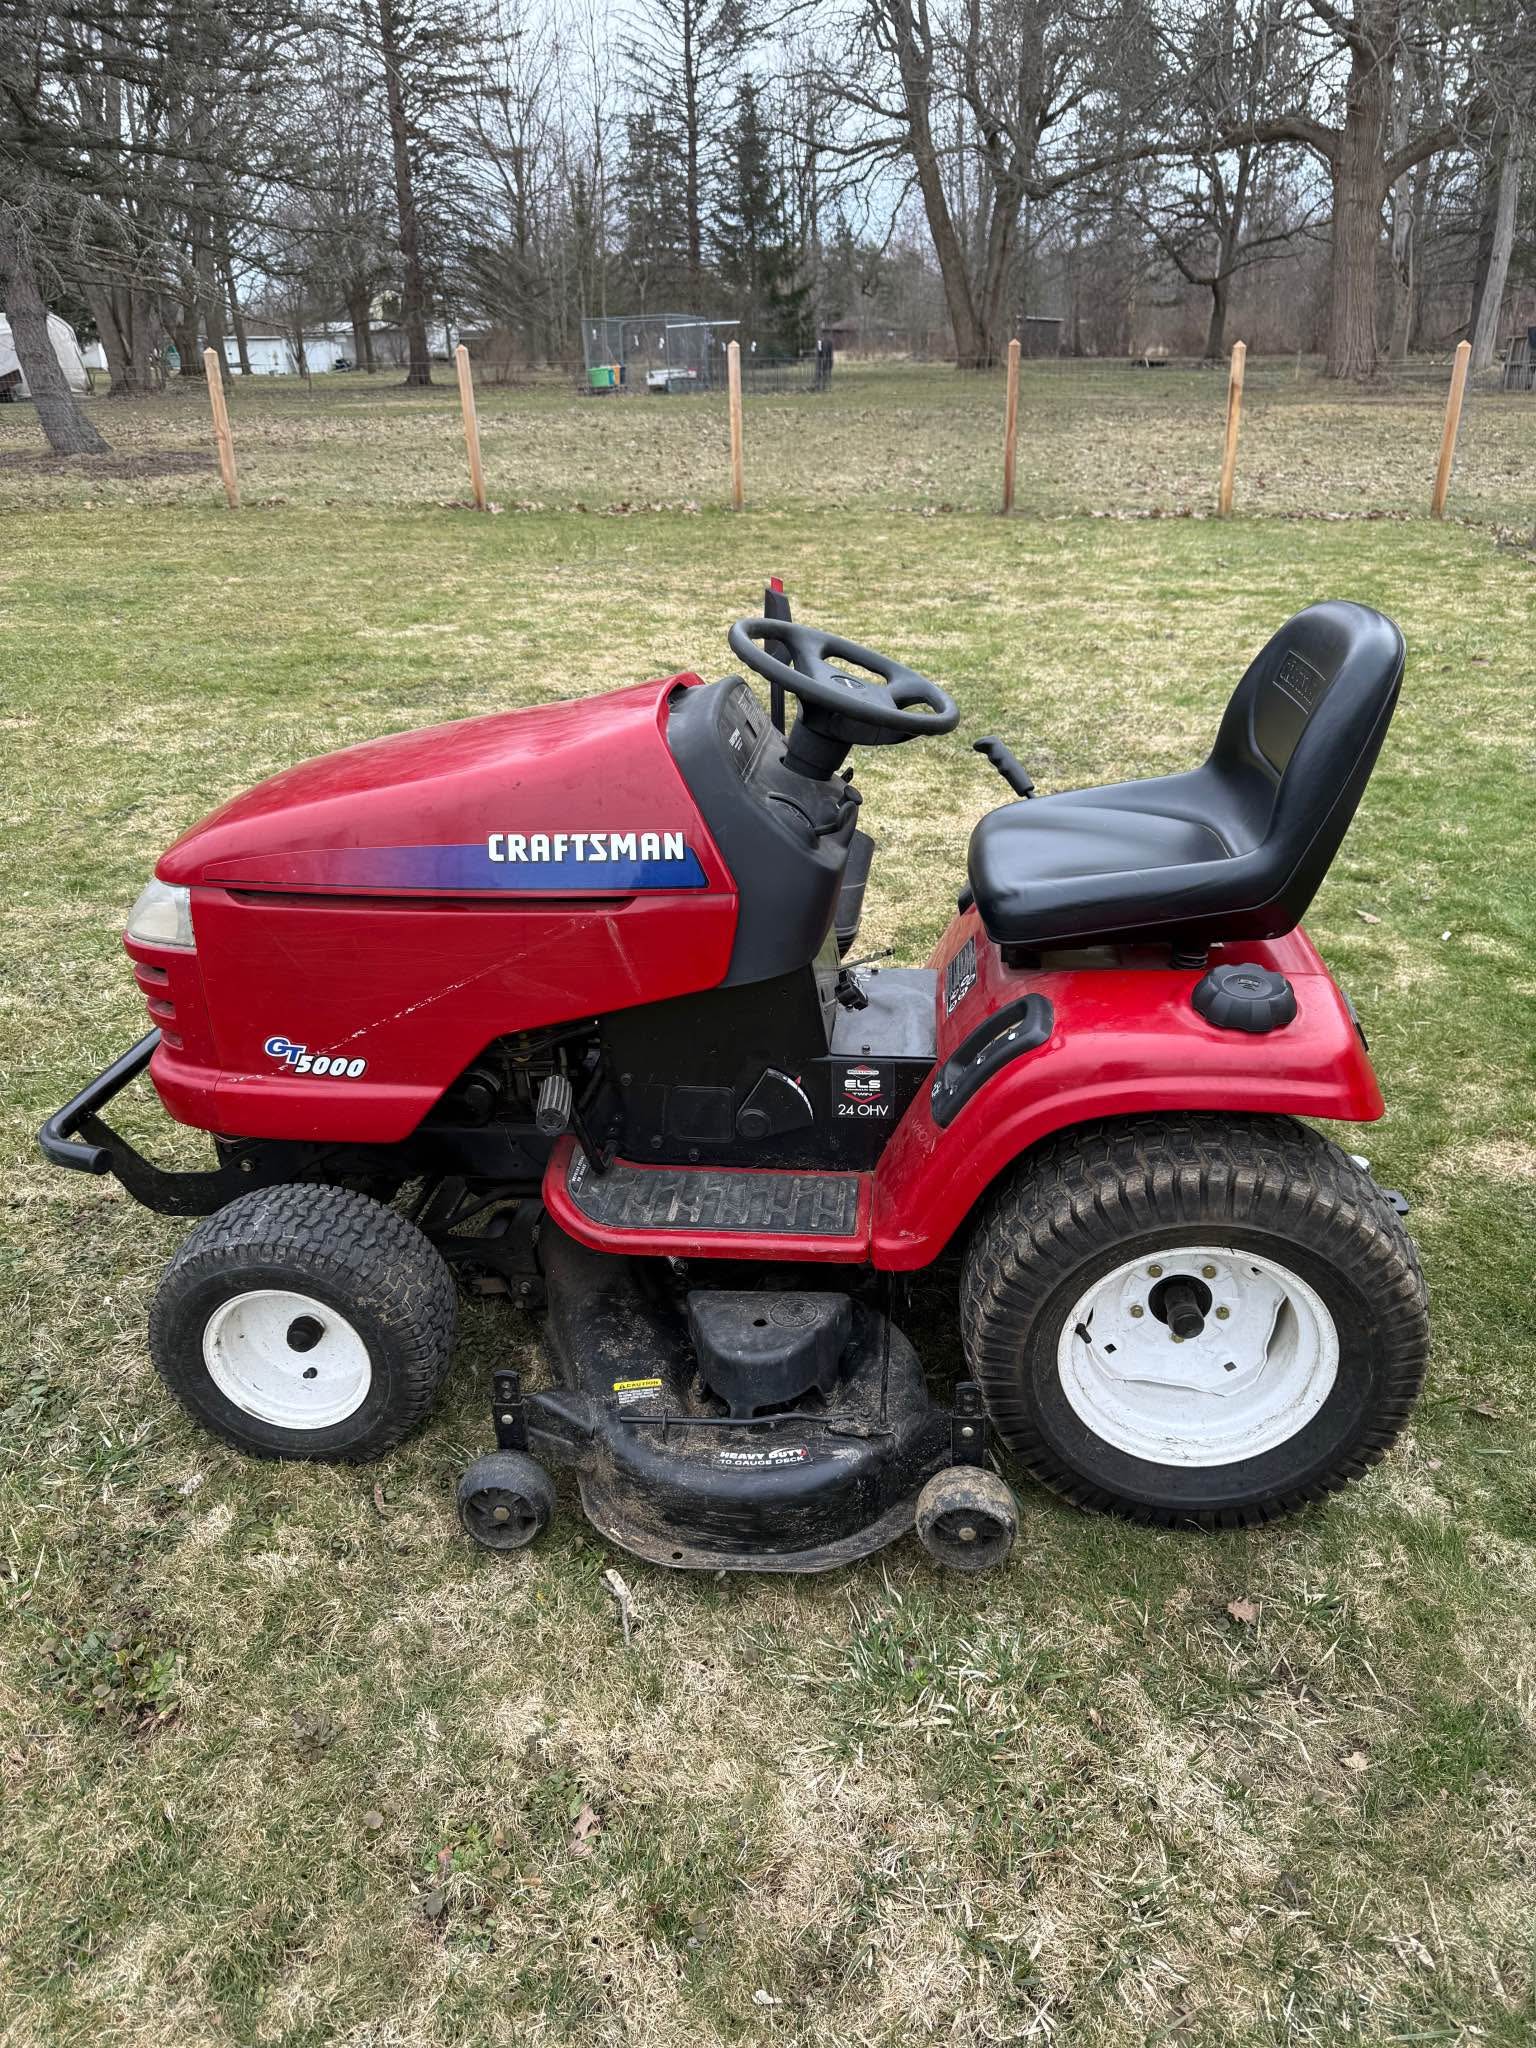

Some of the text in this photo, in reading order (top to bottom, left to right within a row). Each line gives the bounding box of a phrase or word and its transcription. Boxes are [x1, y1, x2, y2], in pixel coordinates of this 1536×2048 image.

[488, 832, 684, 862] CRAFTSMAN
[264, 1036, 366, 1078] GT 5000
[844, 1079, 881, 1089] ELS
[838, 1104, 889, 1116] 24 OHV
[626, 1380, 659, 1388] CAUTION
[720, 1448, 803, 1460] HEAVY DUTY
[775, 1456, 804, 1465] DECK
